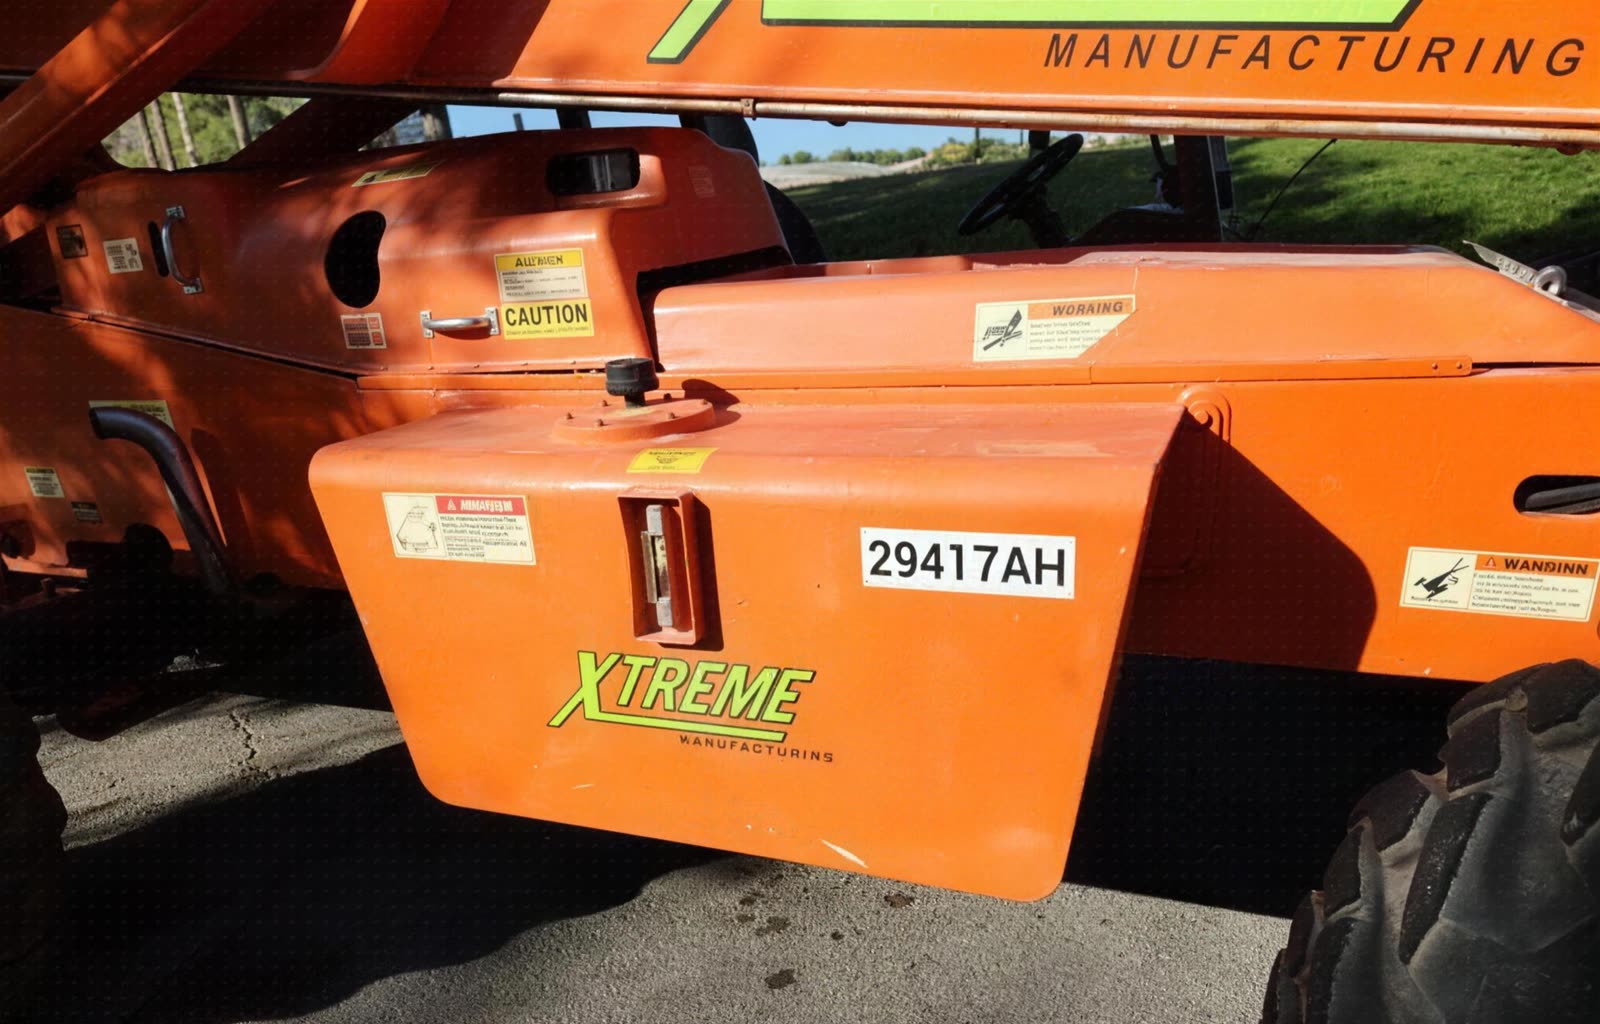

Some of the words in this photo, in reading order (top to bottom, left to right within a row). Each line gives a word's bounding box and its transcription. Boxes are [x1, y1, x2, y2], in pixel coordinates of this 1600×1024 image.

[1043, 33, 1586, 77] MANUFACTURING
[505, 303, 588, 327] CAUTION
[868, 540, 1065, 586] 29417AH
[547, 650, 815, 729] XTREME
